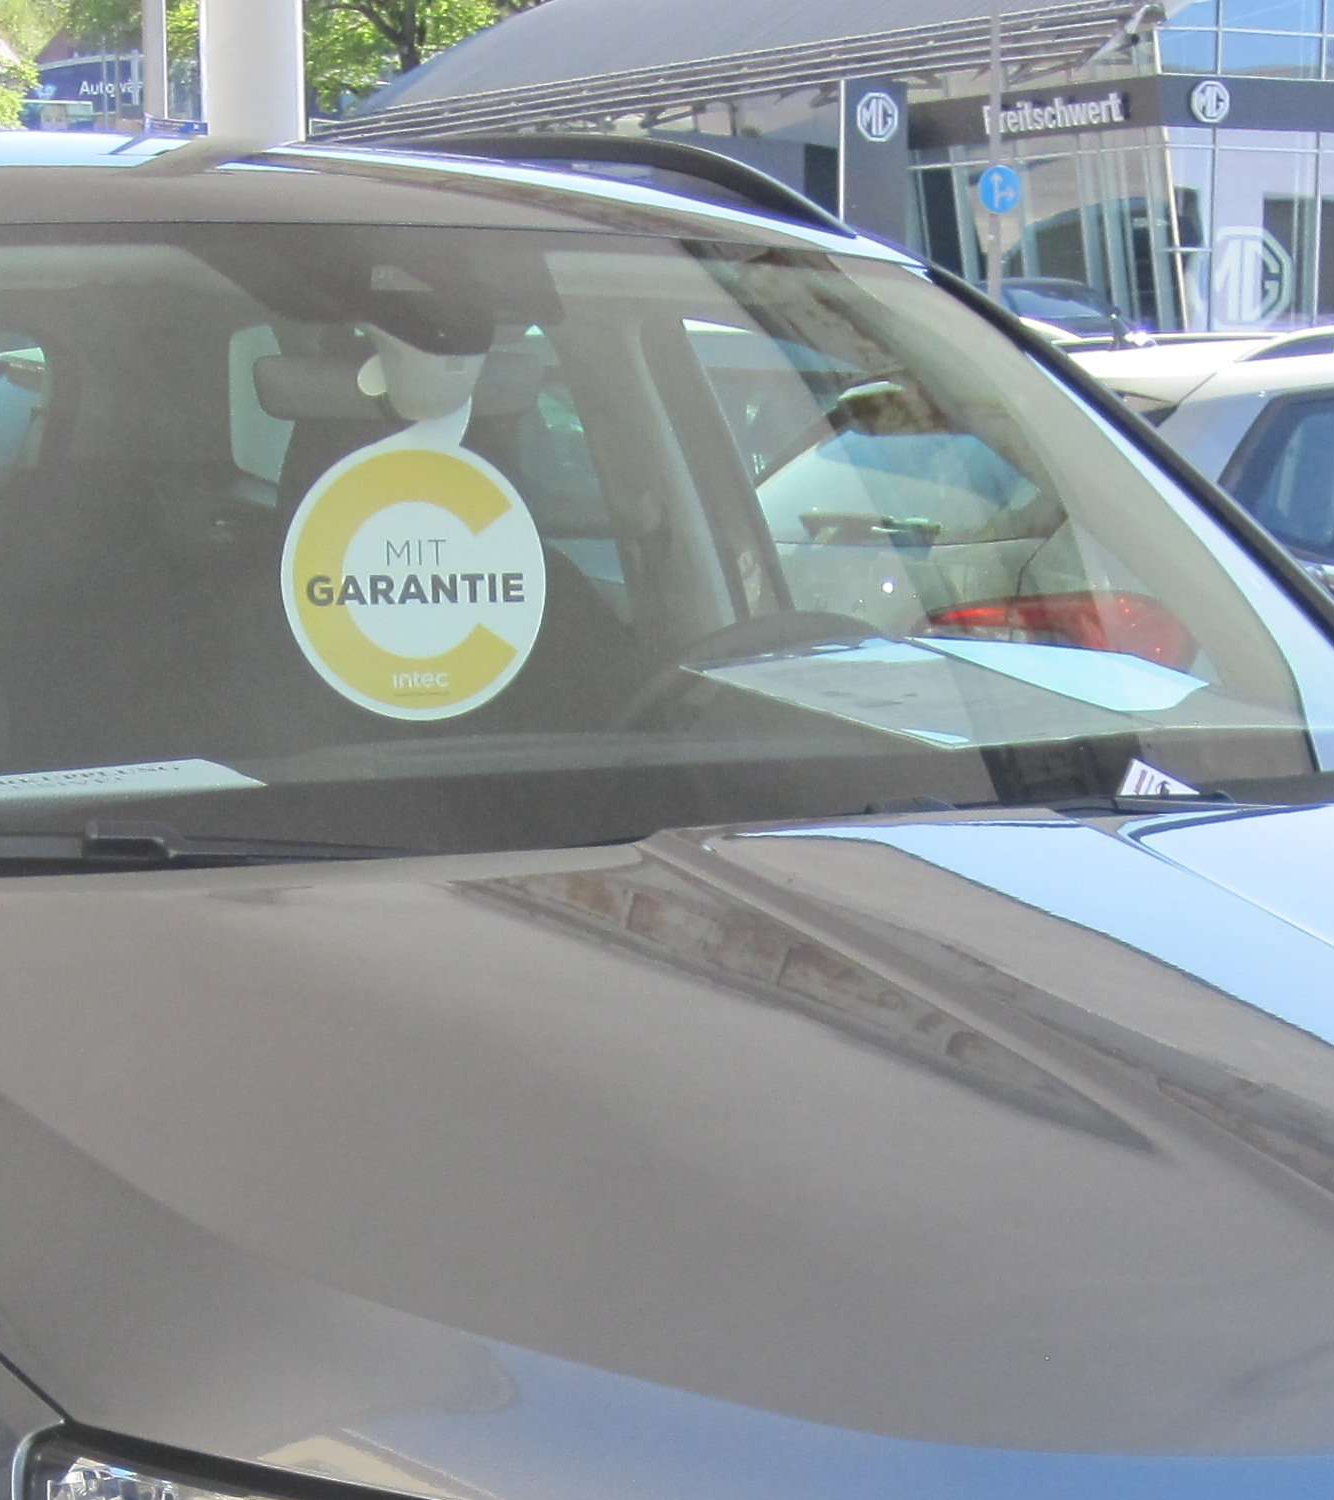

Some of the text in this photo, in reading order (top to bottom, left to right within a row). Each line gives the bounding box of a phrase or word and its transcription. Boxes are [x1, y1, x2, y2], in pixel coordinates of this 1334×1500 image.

[859, 95, 896, 140] MG
[386, 539, 446, 566] MIT
[306, 572, 525, 607] GARANTIE
